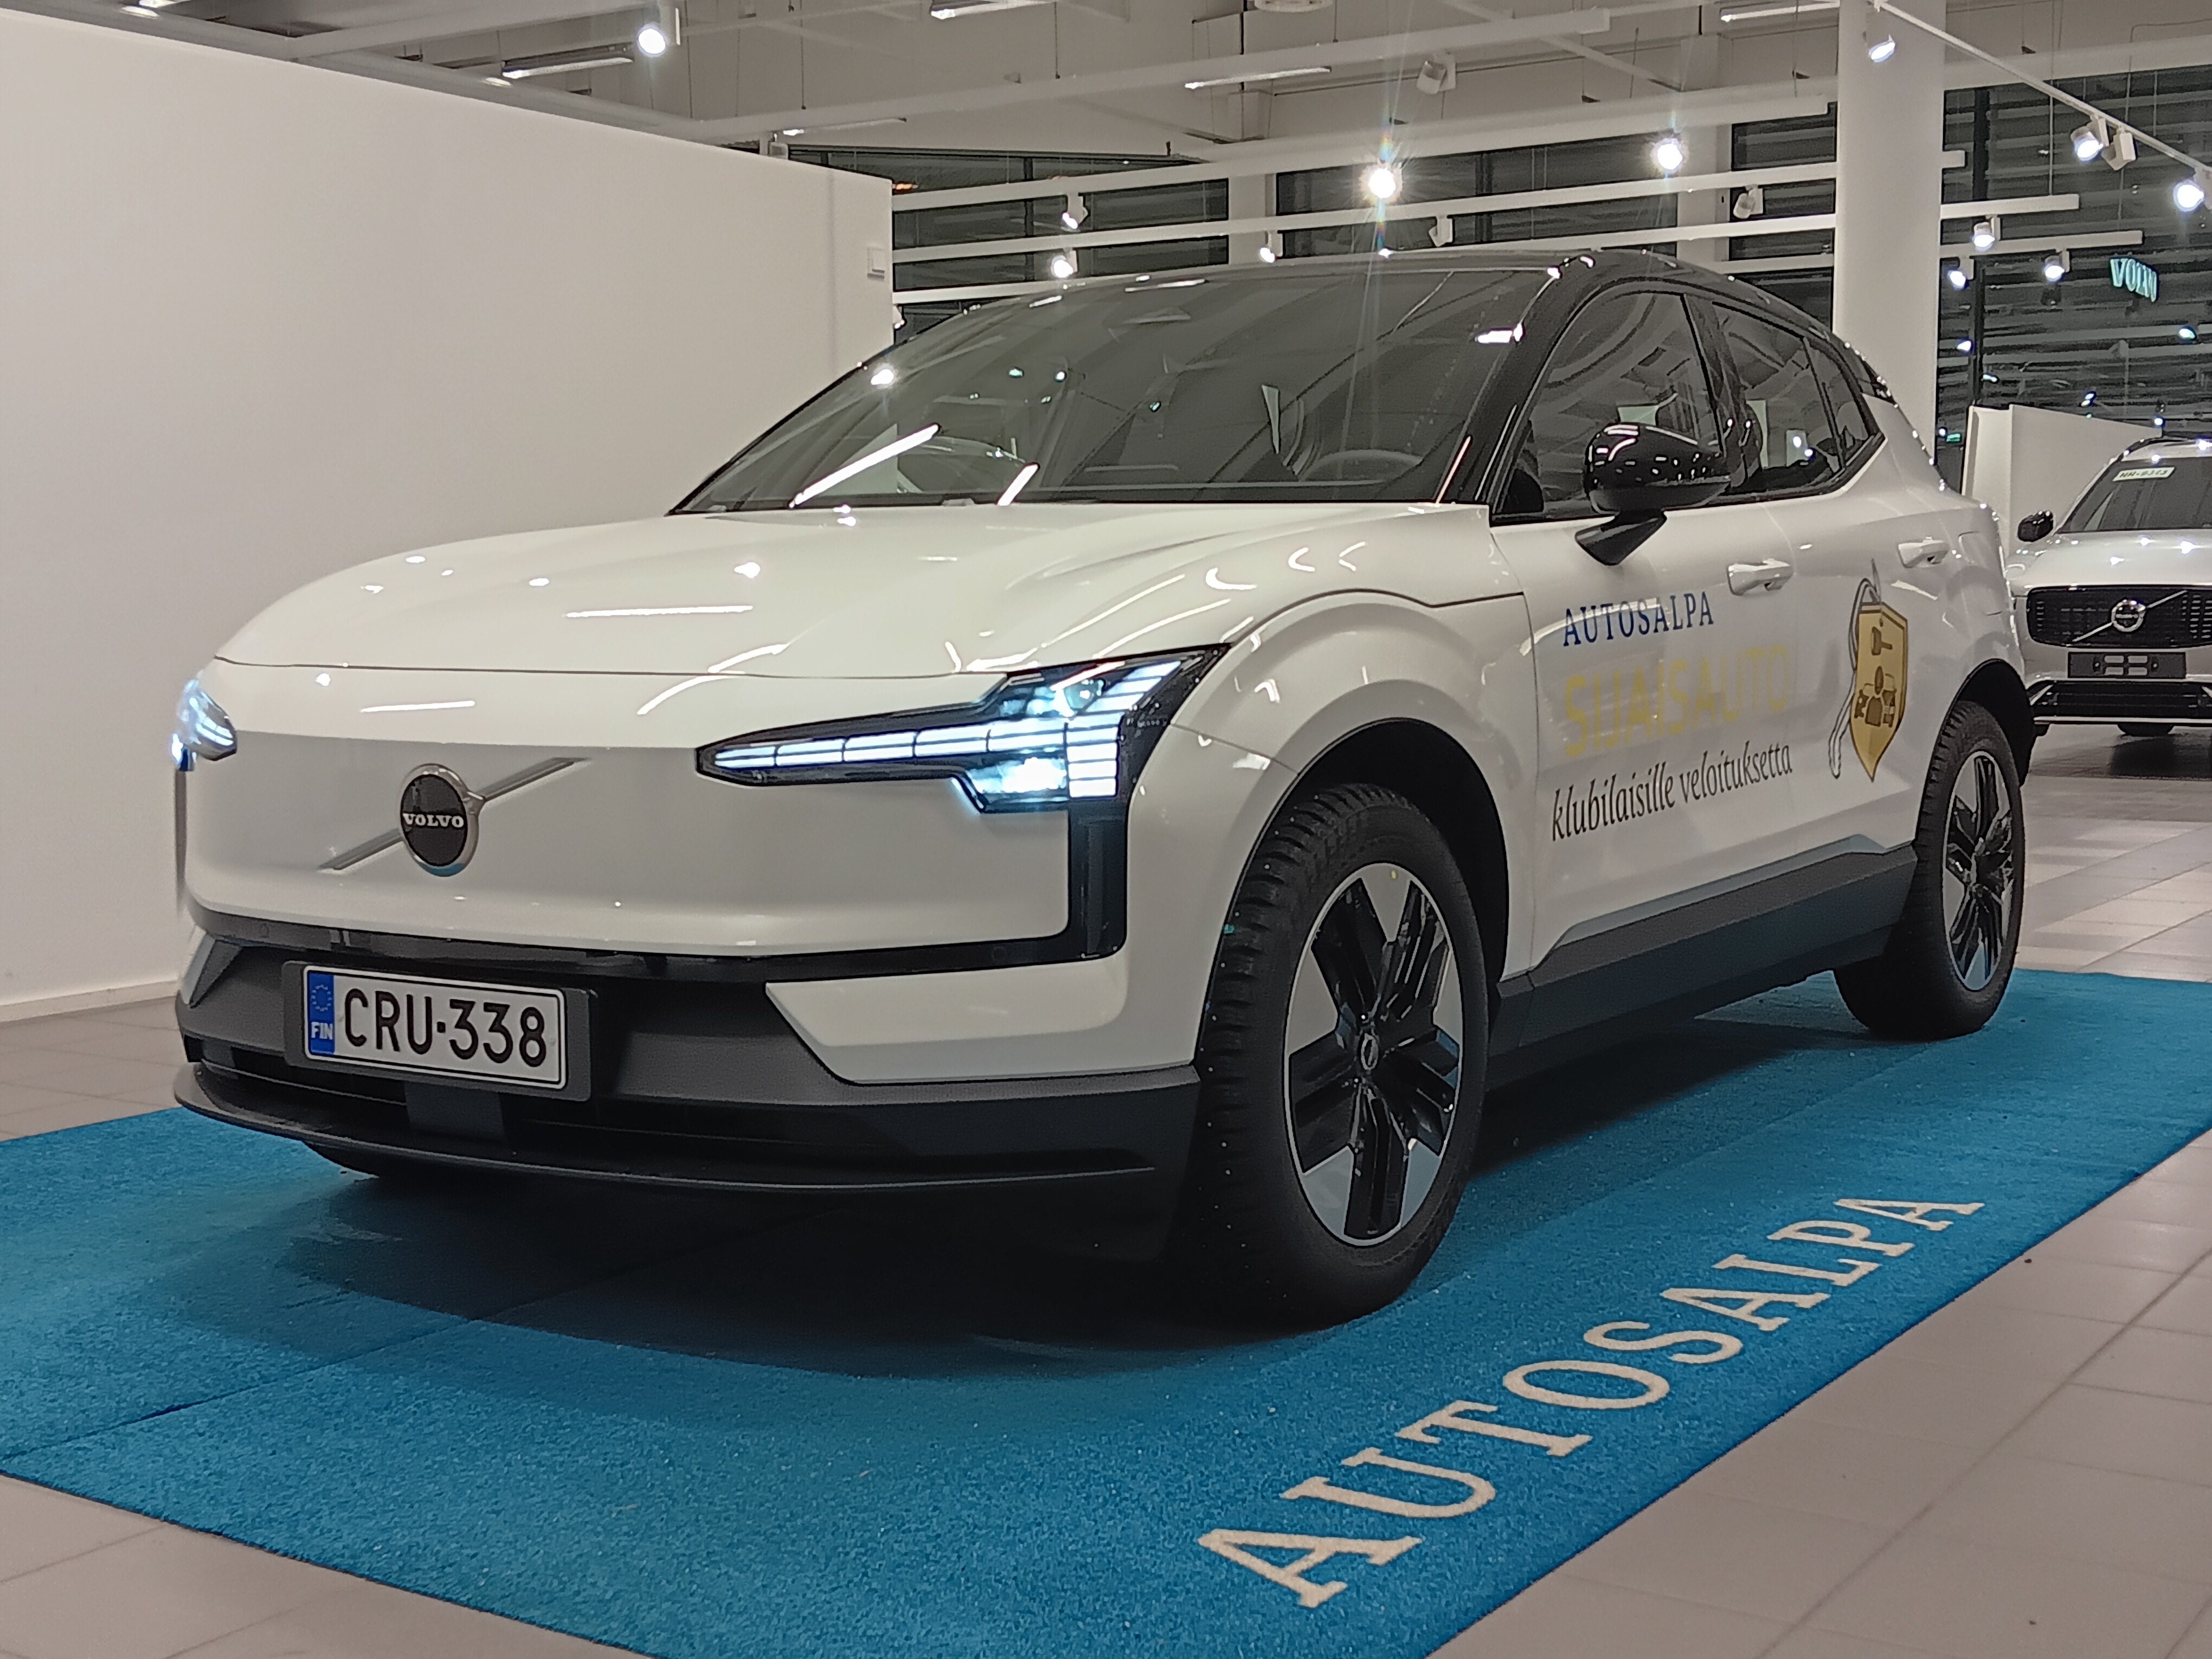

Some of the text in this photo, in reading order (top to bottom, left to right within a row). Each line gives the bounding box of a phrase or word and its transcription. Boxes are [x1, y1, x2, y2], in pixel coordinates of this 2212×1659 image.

[1563, 591, 1714, 646] AUTOSALPA
[1564, 645, 1791, 756] SIJAISAUTO
[403, 813, 465, 828] VOLVO
[1552, 741, 1793, 841] klubilaisille veloituksetta
[311, 1021, 333, 1041] FIN
[344, 988, 547, 1067] CRU-338
[1198, 1198, 1985, 1608] AUTOSALPA
